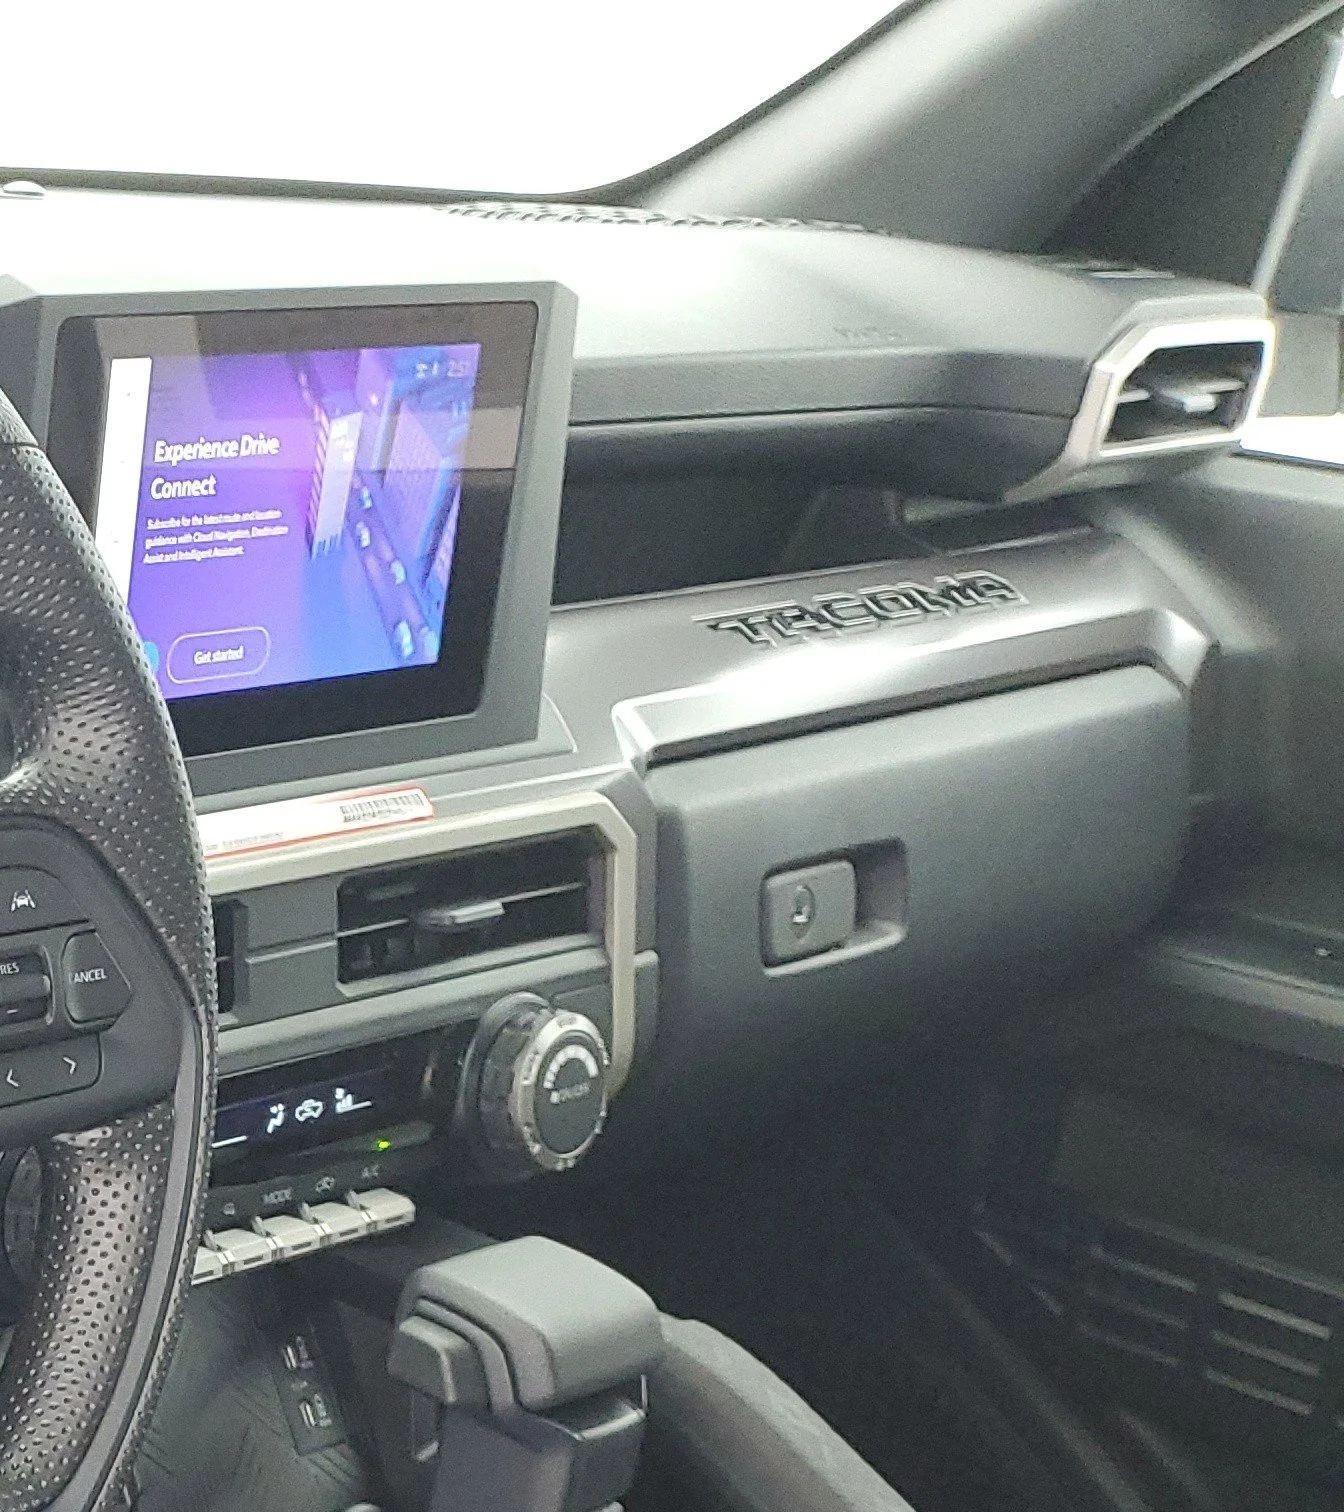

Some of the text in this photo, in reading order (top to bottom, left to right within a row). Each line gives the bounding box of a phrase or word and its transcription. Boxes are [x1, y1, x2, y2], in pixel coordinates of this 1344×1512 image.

[154, 433, 280, 466] Experience Drive
[150, 474, 217, 500] Connect
[692, 570, 1029, 648] TACOMA
